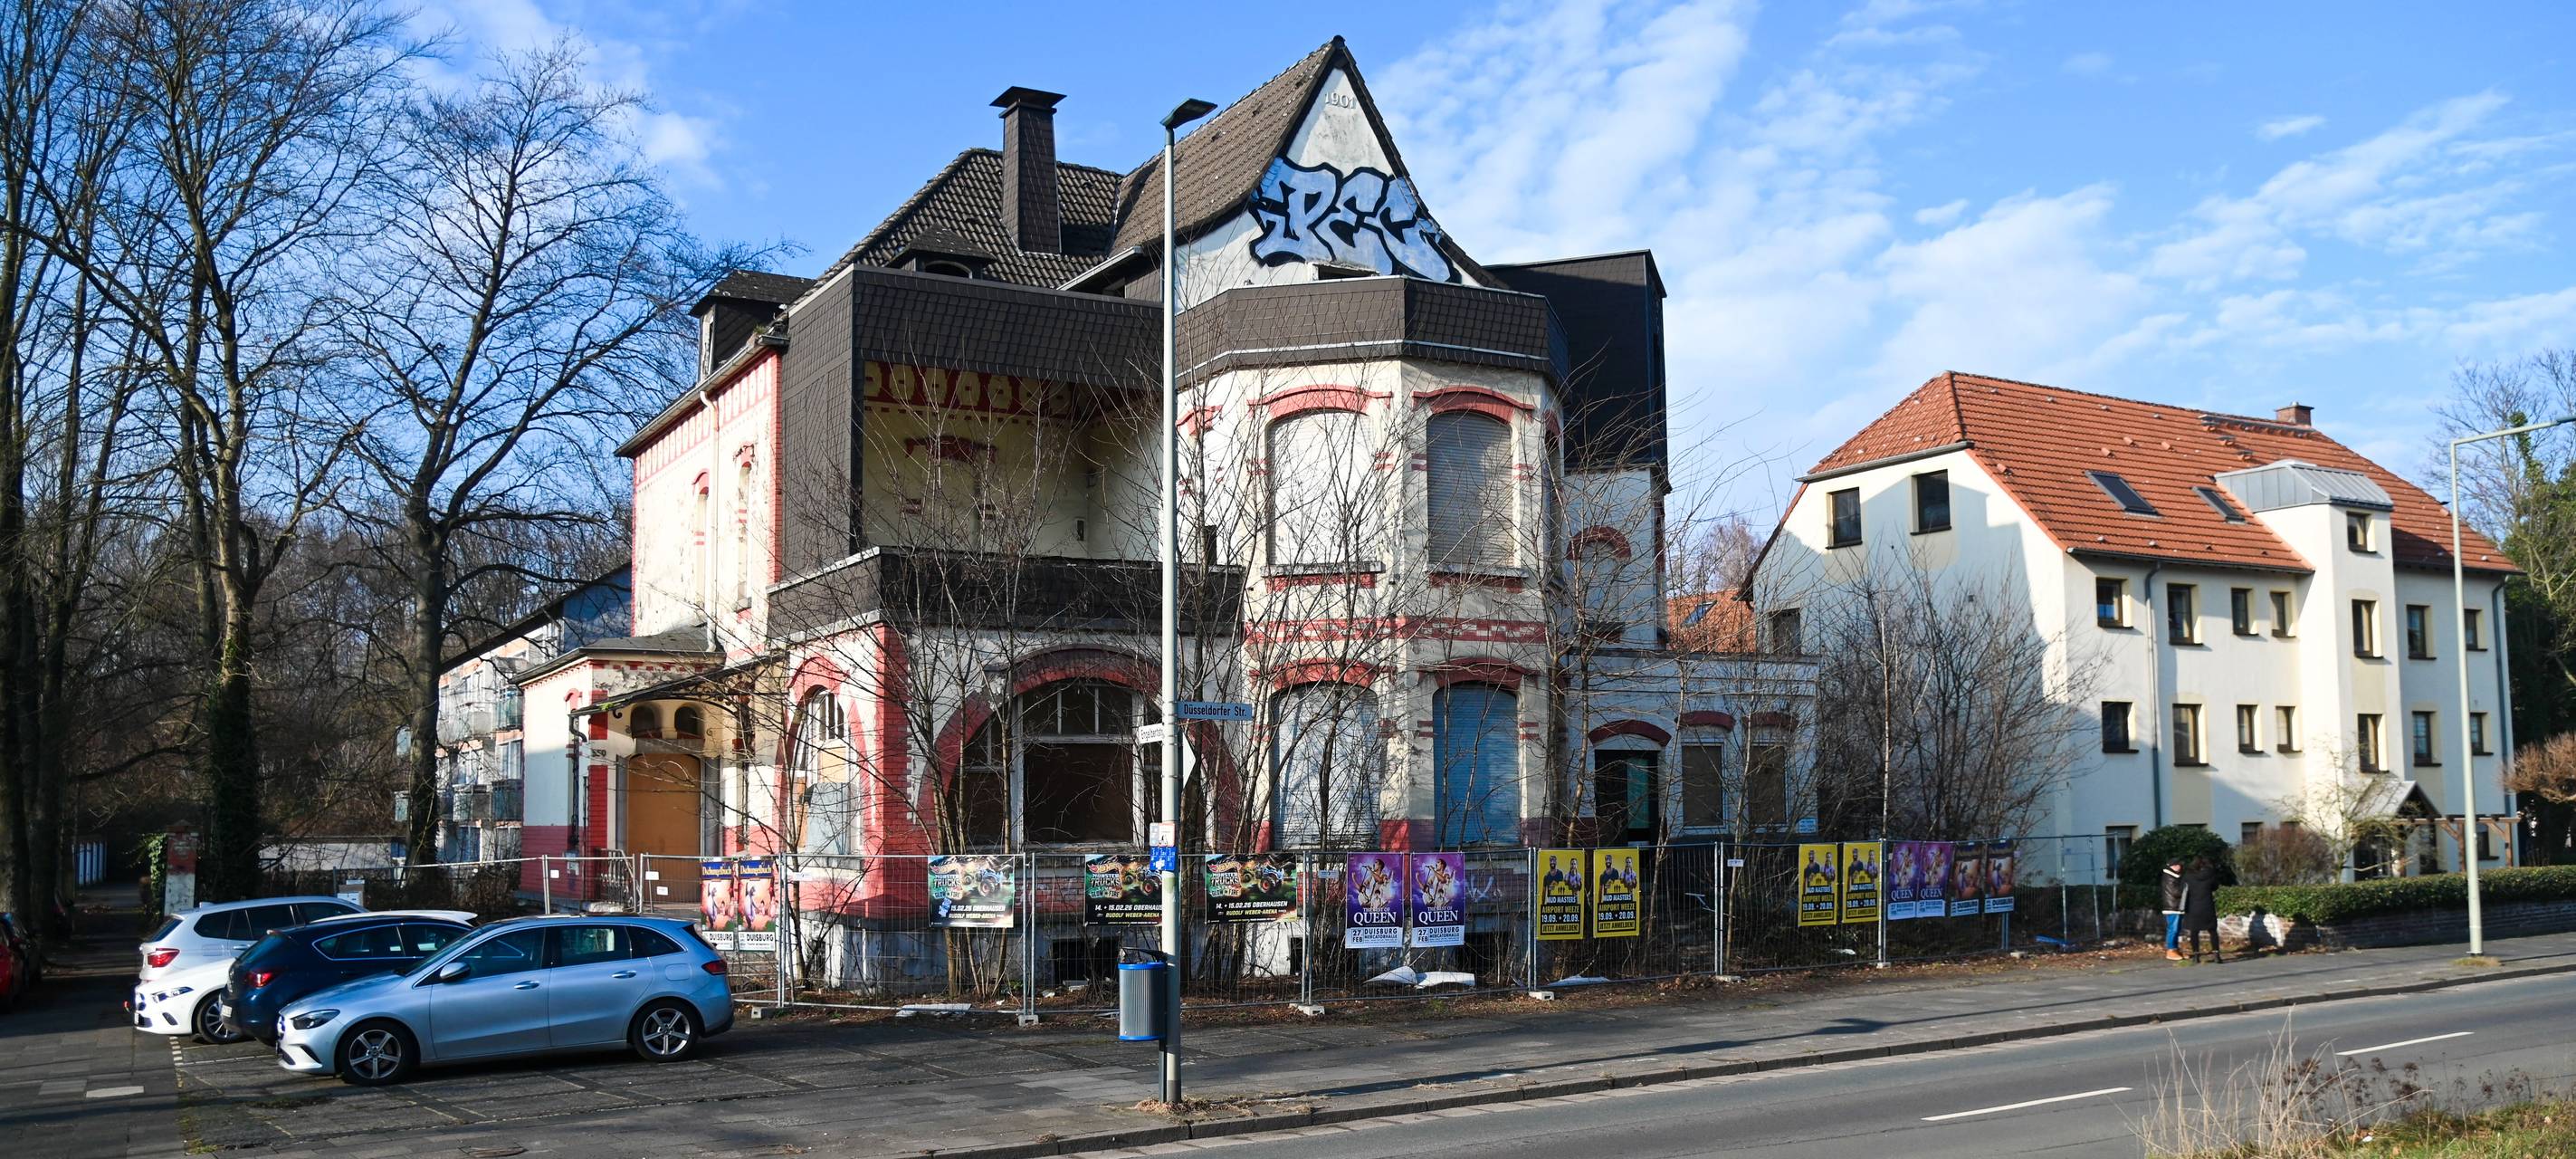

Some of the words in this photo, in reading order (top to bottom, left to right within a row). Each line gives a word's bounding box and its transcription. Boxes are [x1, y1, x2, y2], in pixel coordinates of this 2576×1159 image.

[1324, 91, 1357, 109] 1901
[1184, 704, 1231, 716] Düsseldorfer
[1234, 705, 1246, 716] Str.
[934, 878, 960, 887] TRUCKS
[1091, 877, 1121, 887] TRUCKS
[1211, 876, 1239, 886] TRUCKS
[1891, 889, 1913, 901] QUEEN
[1921, 888, 1942, 899] QUEEN
[1353, 912, 1397, 925] QUEEN
[1418, 910, 1458, 924] QUEEN
[1563, 914, 1579, 922] 20.09.
[1618, 911, 1636, 919] 20.09.
[1542, 924, 1555, 933] JETZT
[746, 934, 774, 942] DUISBURG
